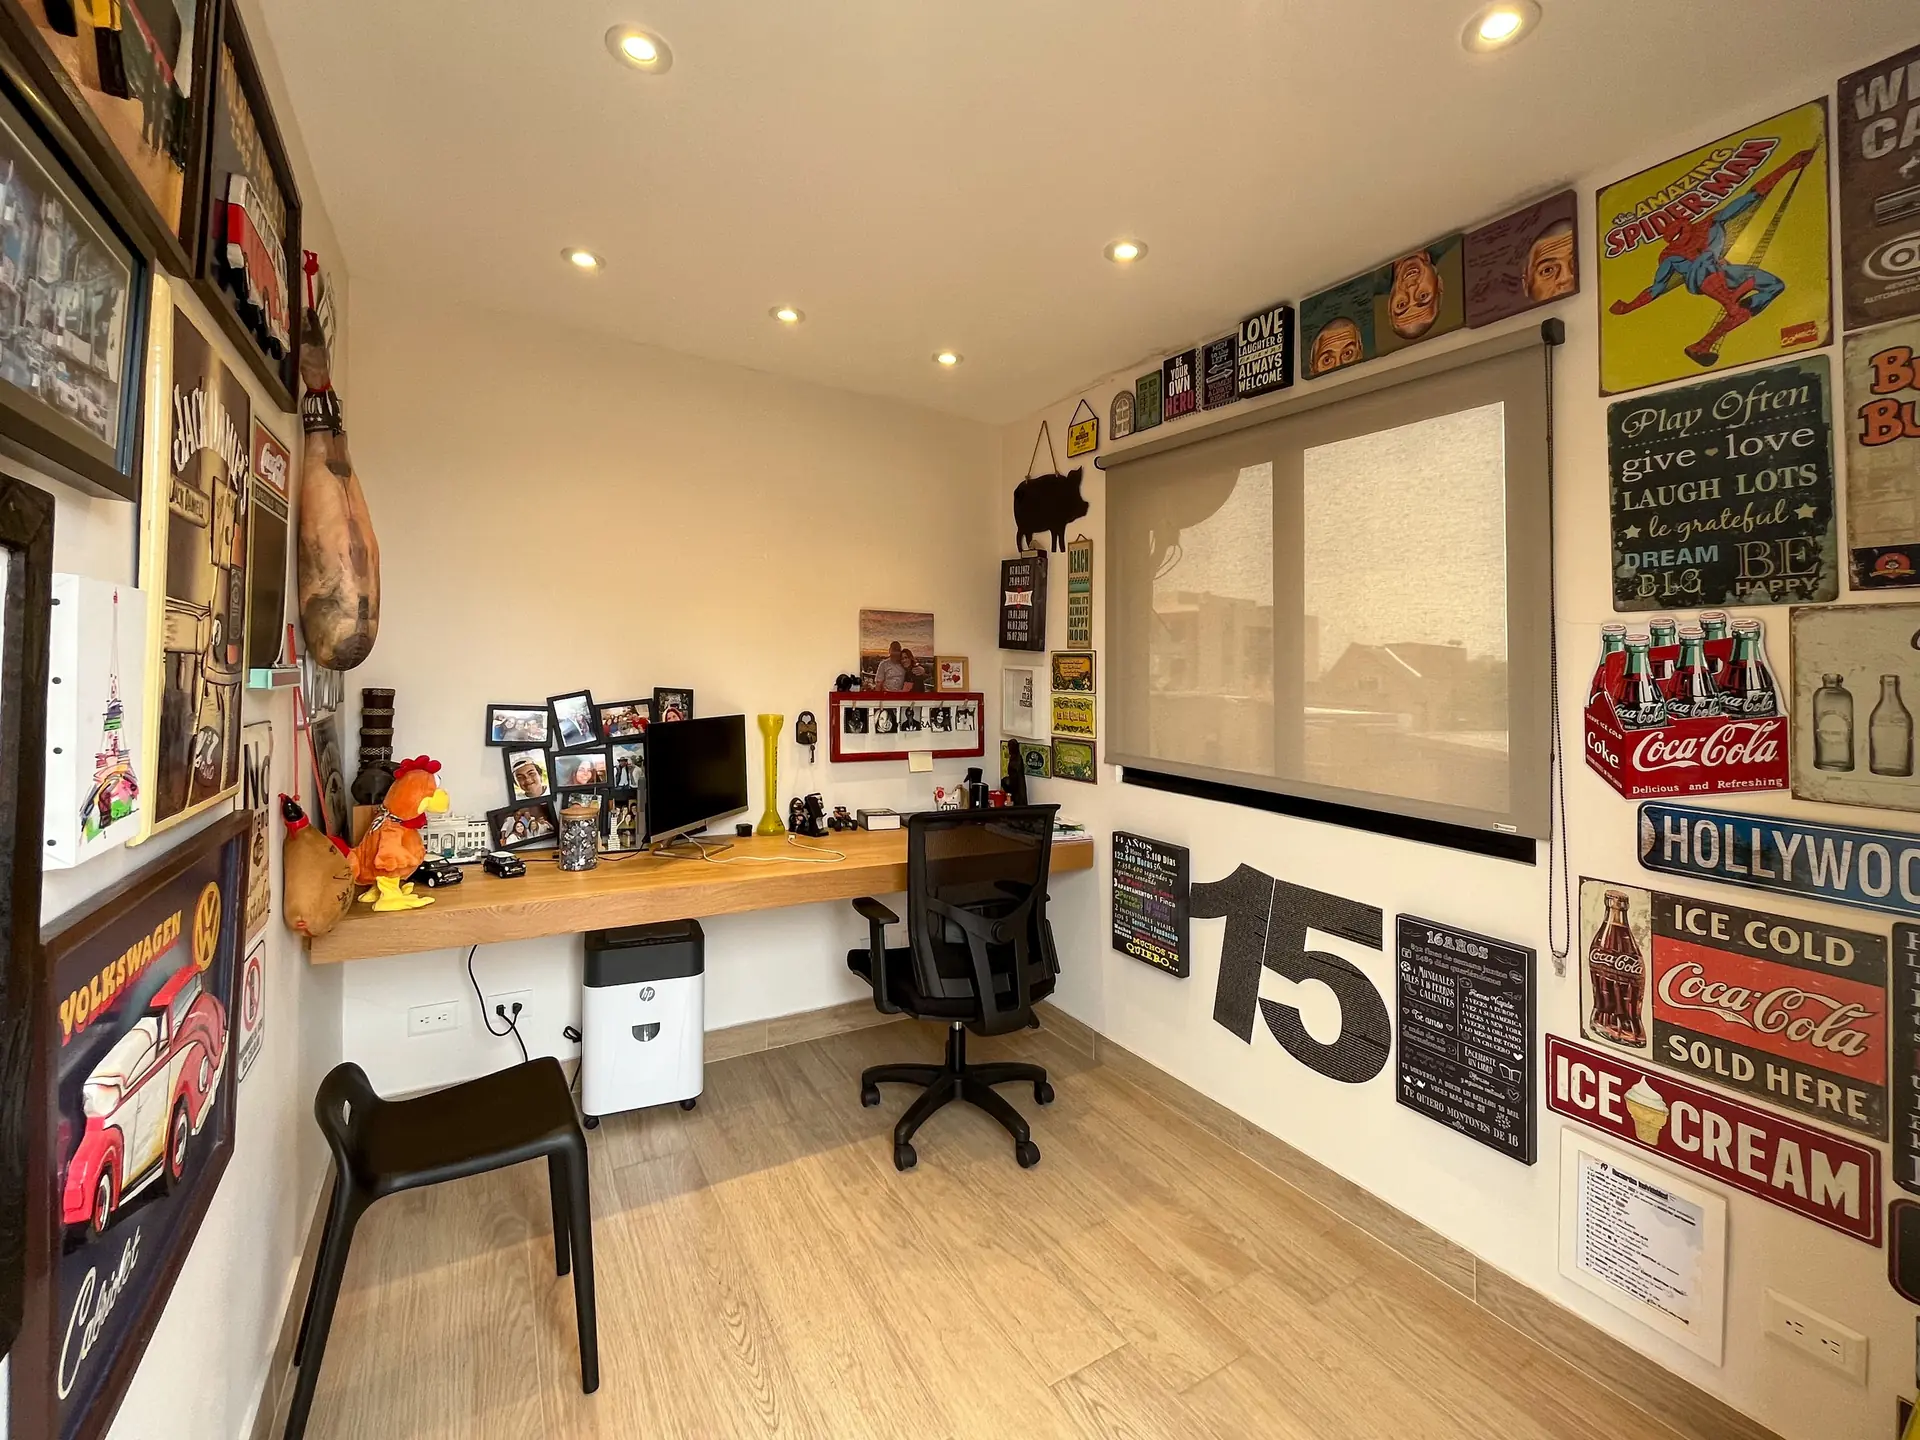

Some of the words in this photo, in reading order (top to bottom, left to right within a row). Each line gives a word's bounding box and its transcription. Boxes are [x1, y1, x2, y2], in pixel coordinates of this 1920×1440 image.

[1636, 147, 1737, 218] AMAZING
[1604, 137, 1780, 258] SPIDER-MAN
[1239, 307, 1284, 346] LOVE
[1238, 337, 1276, 358] LAUGHTER
[1277, 333, 1283, 343] &
[1170, 364, 1189, 381] YOUR
[1176, 356, 1183, 367] BE
[1238, 353, 1283, 380] ALWAYS
[1168, 377, 1191, 397] OWN
[1238, 368, 1283, 393] WELCOME
[1165, 389, 1195, 417] HERO
[1621, 408, 1702, 438] Play
[1712, 380, 1810, 429] Often
[1622, 448, 1697, 483] give
[1725, 427, 1815, 460] love
[1622, 477, 1722, 511] LAUGH
[1736, 463, 1818, 496] LOTS
[1677, 499, 1789, 543] grateful
[1070, 549, 1089, 573] BEACH
[1624, 545, 1719, 570] DREAM
[1734, 535, 1820, 580] BE
[1735, 576, 1817, 596] HAPPY
[1069, 617, 1088, 628] HAPPY
[1069, 629, 1088, 641] HOUR
[1667, 698, 1720, 717] Coca-Cola
[1719, 690, 1774, 713] Coca-Cola
[1587, 731, 1620, 769] Coke
[1632, 721, 1781, 772] Coca-Cola
[1632, 783, 1680, 795] Delicious
[1689, 780, 1709, 792] and
[1717, 777, 1783, 790] Refreshing
[1126, 838, 1152, 850] AÑOS
[1117, 884, 1153, 899] APARTAMENTOS
[1159, 897, 1175, 906] Finca
[1119, 908, 1153, 923] INOLVIDABLE
[1156, 922, 1174, 931] VIAJES
[1132, 937, 1166, 955] MUCHOS
[1167, 951, 1179, 961] TE
[1675, 904, 1730, 940] ICE
[1744, 920, 1855, 967] COLD
[60, 910, 182, 1036] VOLKSWAGEN
[1589, 948, 1643, 975] Coca-Cola
[639, 986, 656, 1002] hp
[1657, 961, 1879, 1057] Coca-Cola
[1668, 1033, 1755, 1082] SOLD
[1766, 1063, 1868, 1121] HERE
[1415, 1092, 1444, 1112] QUIERO
[1446, 1105, 1490, 1134] MONTONES
[1556, 1055, 1623, 1124] ICE
[1670, 1100, 1861, 1220] CREAM
